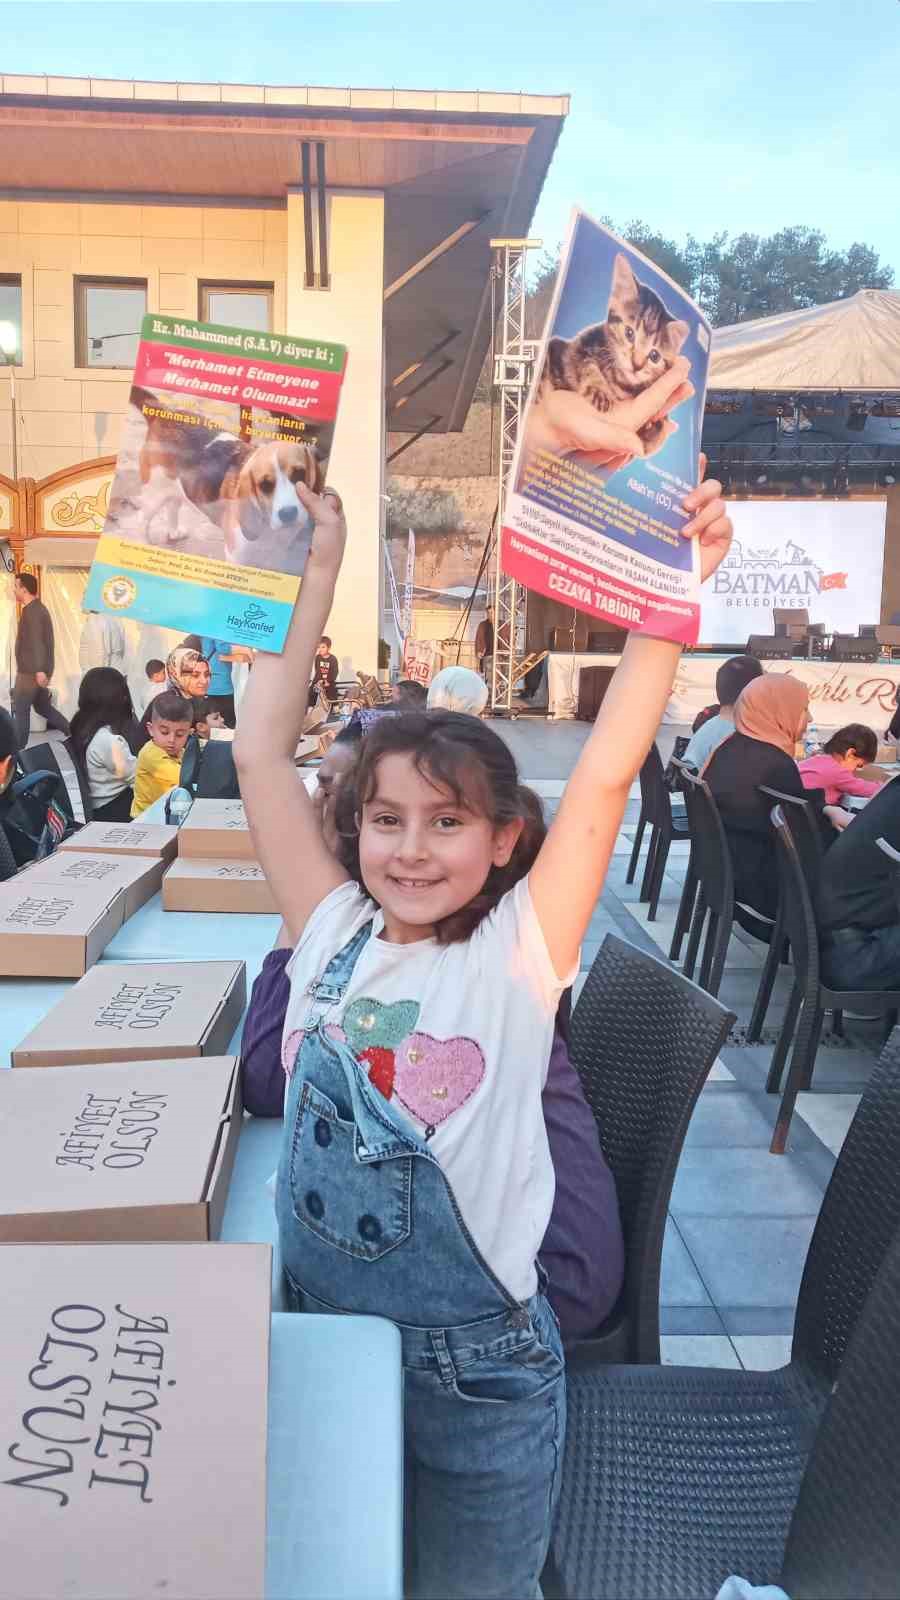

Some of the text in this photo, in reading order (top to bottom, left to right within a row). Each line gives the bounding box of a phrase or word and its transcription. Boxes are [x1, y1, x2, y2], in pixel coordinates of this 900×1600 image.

[173, 323, 242, 347] Muhammed
[243, 336, 282, 356] (S.A.V)
[283, 343, 314, 361] diyor
[315, 347, 328, 361] ki
[161, 371, 240, 397] Merhamet
[164, 351, 244, 377] "Merhamet
[246, 366, 320, 391] Etmeyene
[142, 404, 200, 425] korunması
[548, 572, 645, 624] CEZAYA TABİDİR.
[713, 568, 824, 595] BATMAN
[726, 596, 812, 608] BELEDİYESİ
[227, 614, 275, 634] HayKonfed
[94, 983, 150, 1030] AFİYET
[128, 982, 184, 1029] OLSUN
[56, 1093, 122, 1171] AFİYET
[103, 1091, 169, 1169] OLSUN
[1, 1304, 106, 1506] OLSUN
[88, 1304, 177, 1503] AFİYET
